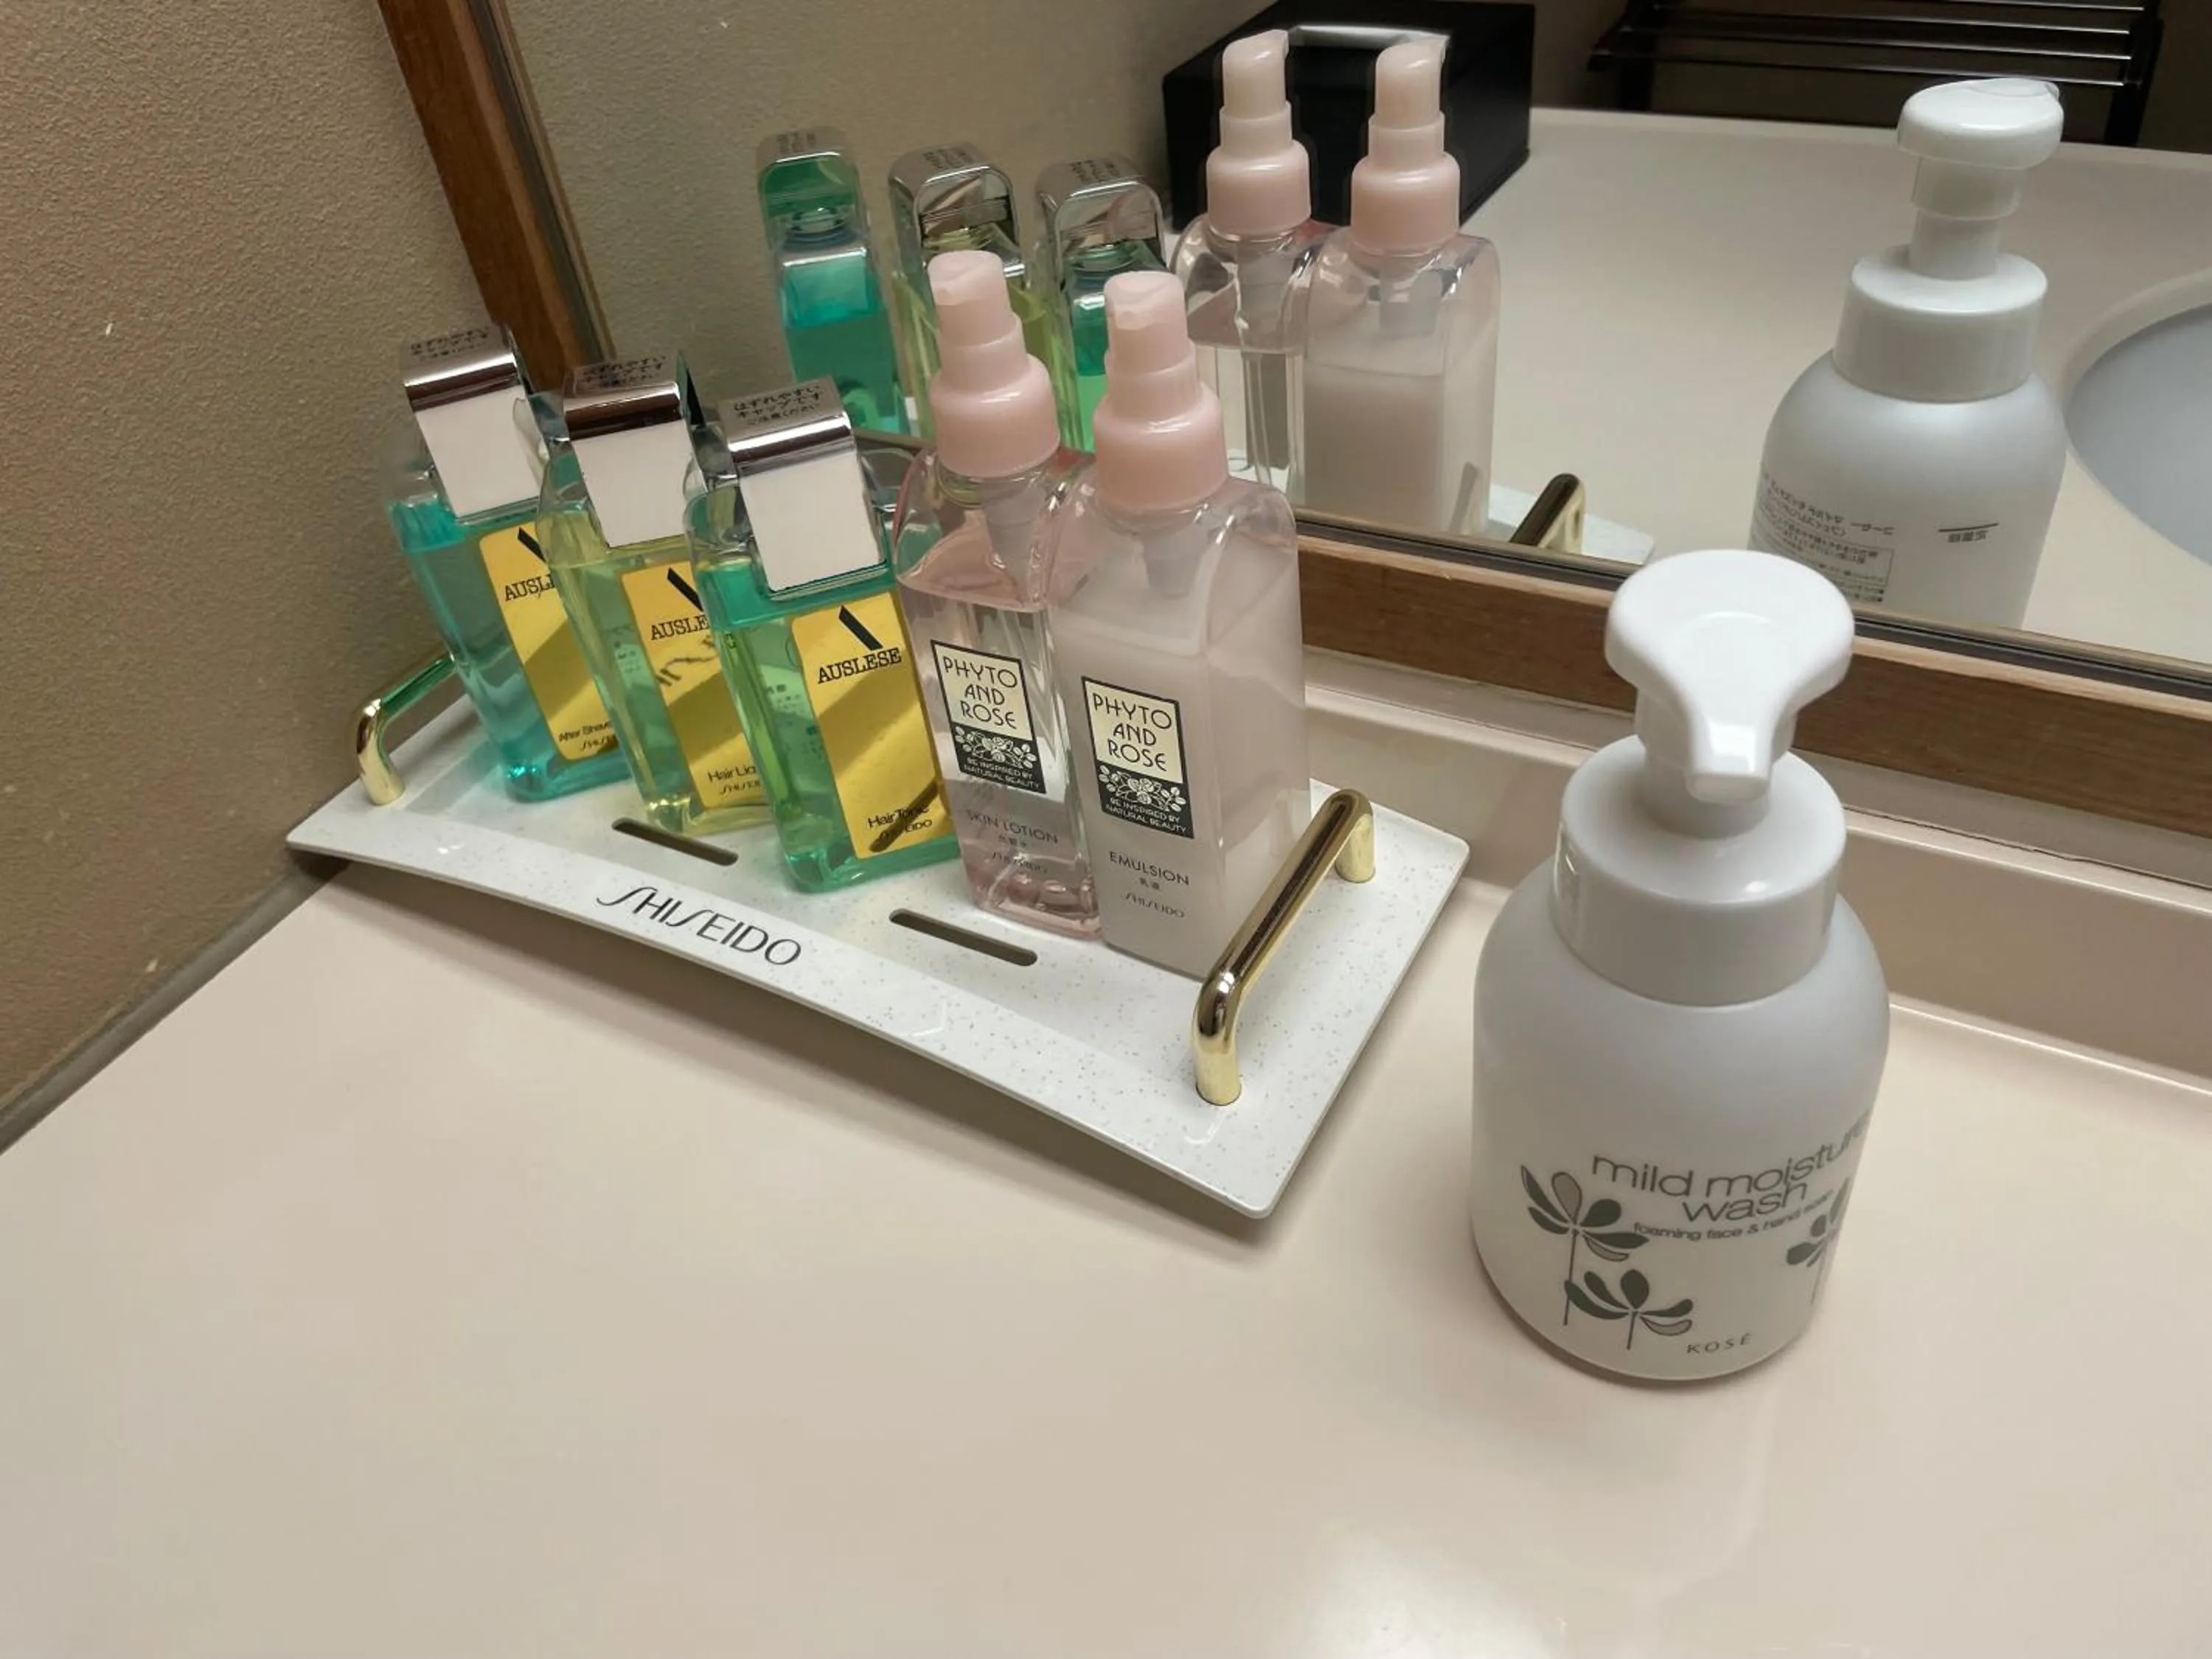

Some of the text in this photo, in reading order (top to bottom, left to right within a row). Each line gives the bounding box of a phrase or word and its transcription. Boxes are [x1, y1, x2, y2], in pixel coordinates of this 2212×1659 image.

[504, 574, 554, 602] AUSL
[650, 614, 710, 641] AUSLE
[818, 647, 902, 685] AUSLESE
[943, 655, 1018, 689] PHYTO
[964, 684, 1005, 706] AND
[960, 700, 1016, 729] ROSE
[1093, 692, 1172, 729] PHYTO
[1113, 723, 1157, 747] AND
[1107, 740, 1168, 772] ROSE
[867, 813, 896, 829] Hair
[1003, 820, 1059, 844] LOTION
[1109, 850, 1190, 886] EMULSION
[596, 886, 802, 965] SHISEIDO
[1592, 1155, 1694, 1198] mild
[1682, 1181, 1808, 1222] wash
[1633, 1222, 1702, 1242] foaming
